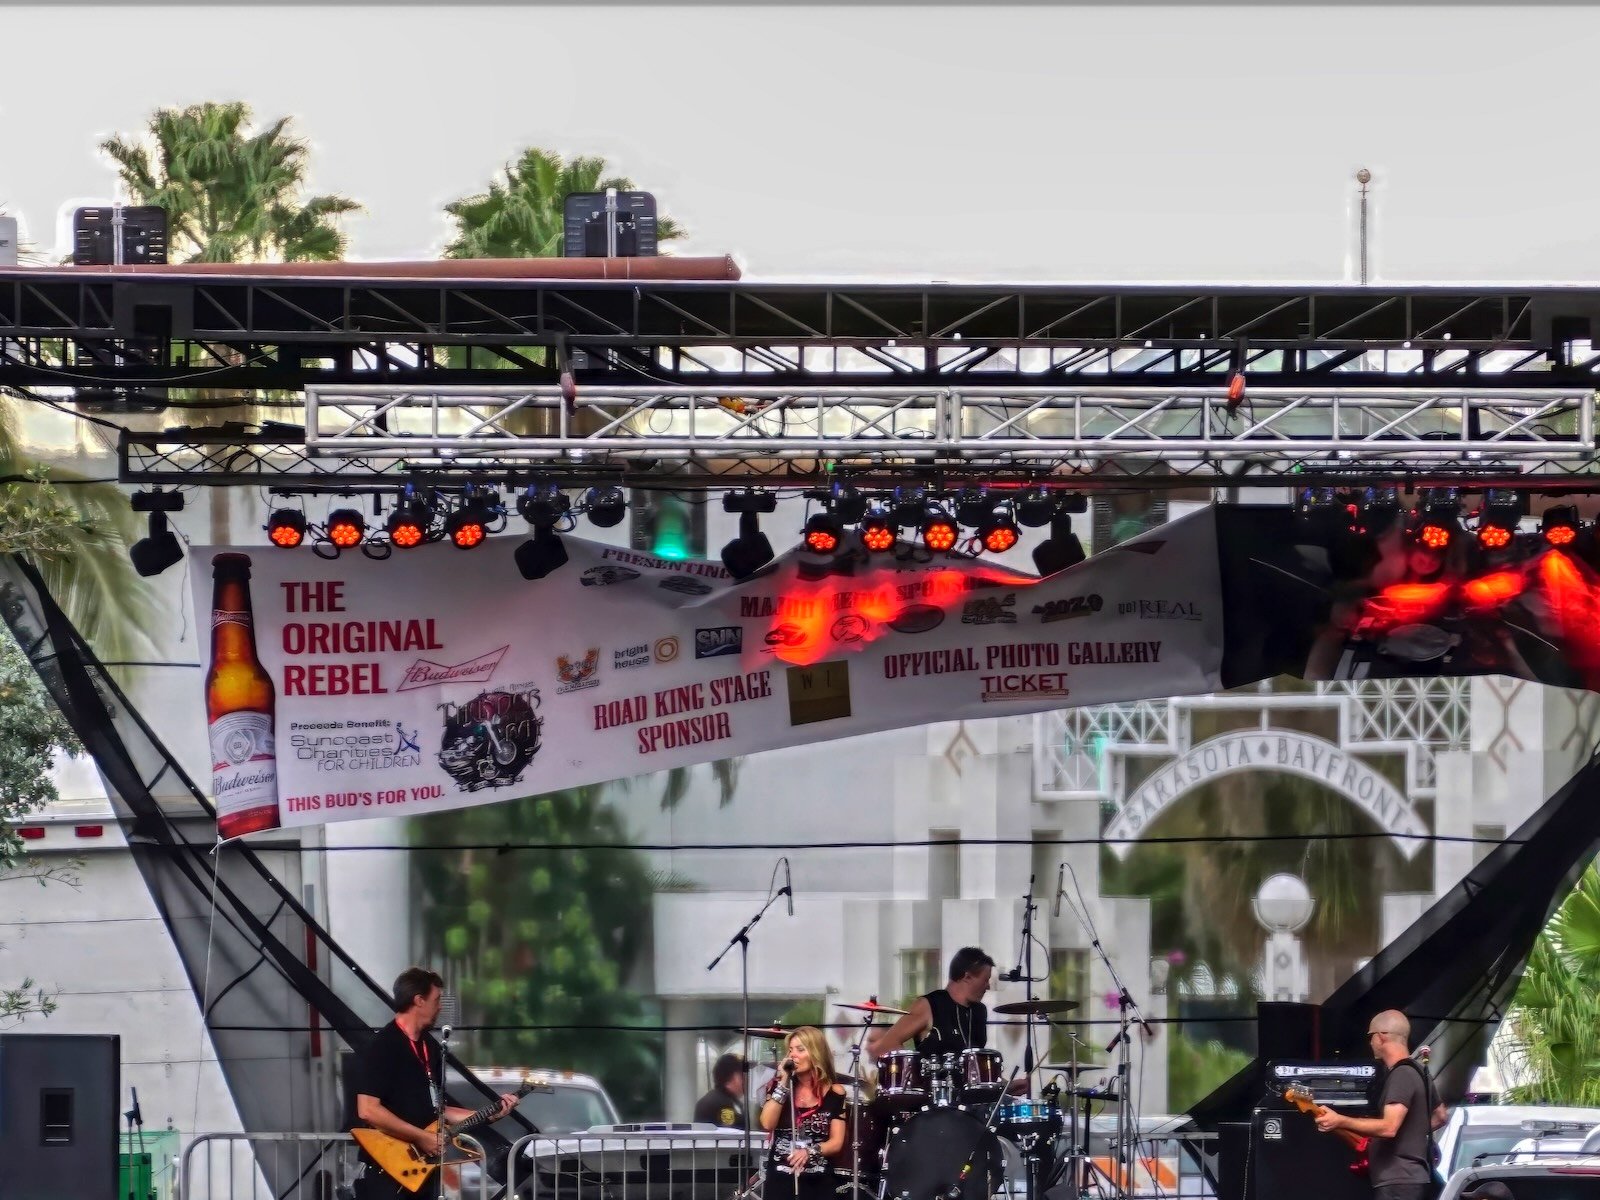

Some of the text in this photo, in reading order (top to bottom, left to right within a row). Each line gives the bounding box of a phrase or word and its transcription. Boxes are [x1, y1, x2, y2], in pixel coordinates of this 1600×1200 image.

[280, 581, 346, 613] THE
[282, 619, 444, 655] ORIGINAL
[614, 643, 649, 661] bright
[614, 655, 650, 670] house
[884, 640, 1162, 679] OFFICIAL PHOTO GALLERY
[283, 663, 388, 696] REBEL
[406, 662, 498, 683] Budweiser
[980, 673, 1068, 693] TICKET
[593, 670, 772, 731] ROAD KING STAGE
[290, 733, 394, 747] Suncoast
[637, 712, 731, 754] SPONSOR
[297, 747, 393, 760] Charities
[317, 755, 422, 772] FOR CHILDREN
[214, 770, 276, 796] Budweiser
[1123, 737, 1412, 829] SARASOTA BAYFRONT
[286, 795, 321, 812] THIS
[325, 791, 373, 808] BUD'S
[377, 789, 406, 804] FOR
[411, 784, 446, 801] YOU.
